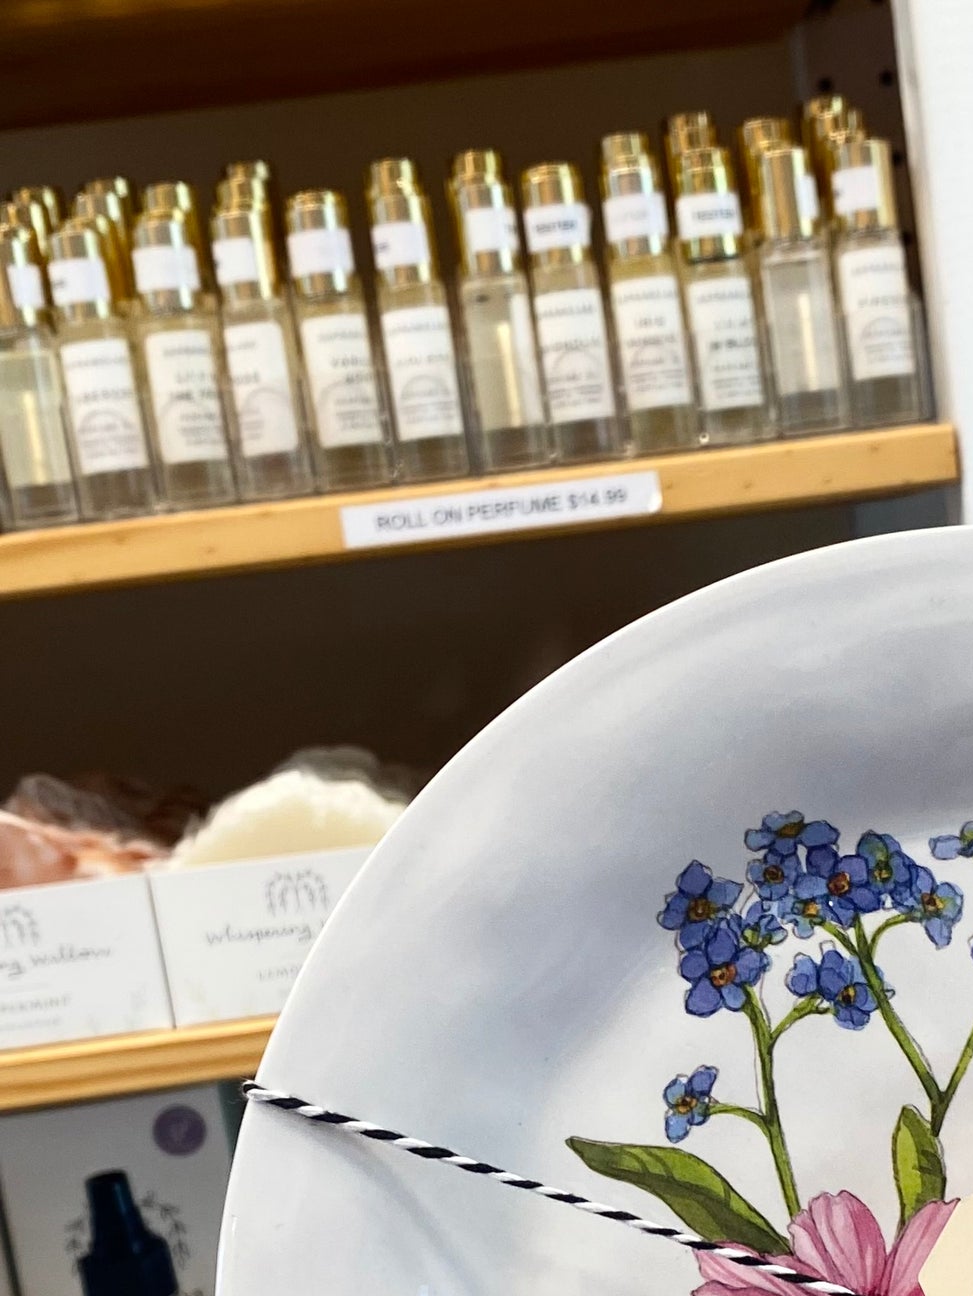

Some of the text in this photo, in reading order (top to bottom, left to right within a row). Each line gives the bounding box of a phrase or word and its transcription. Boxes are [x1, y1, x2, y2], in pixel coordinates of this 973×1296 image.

[376, 512, 427, 532] ROLL
[432, 507, 463, 527] ON
[467, 494, 561, 522] PERFUME
